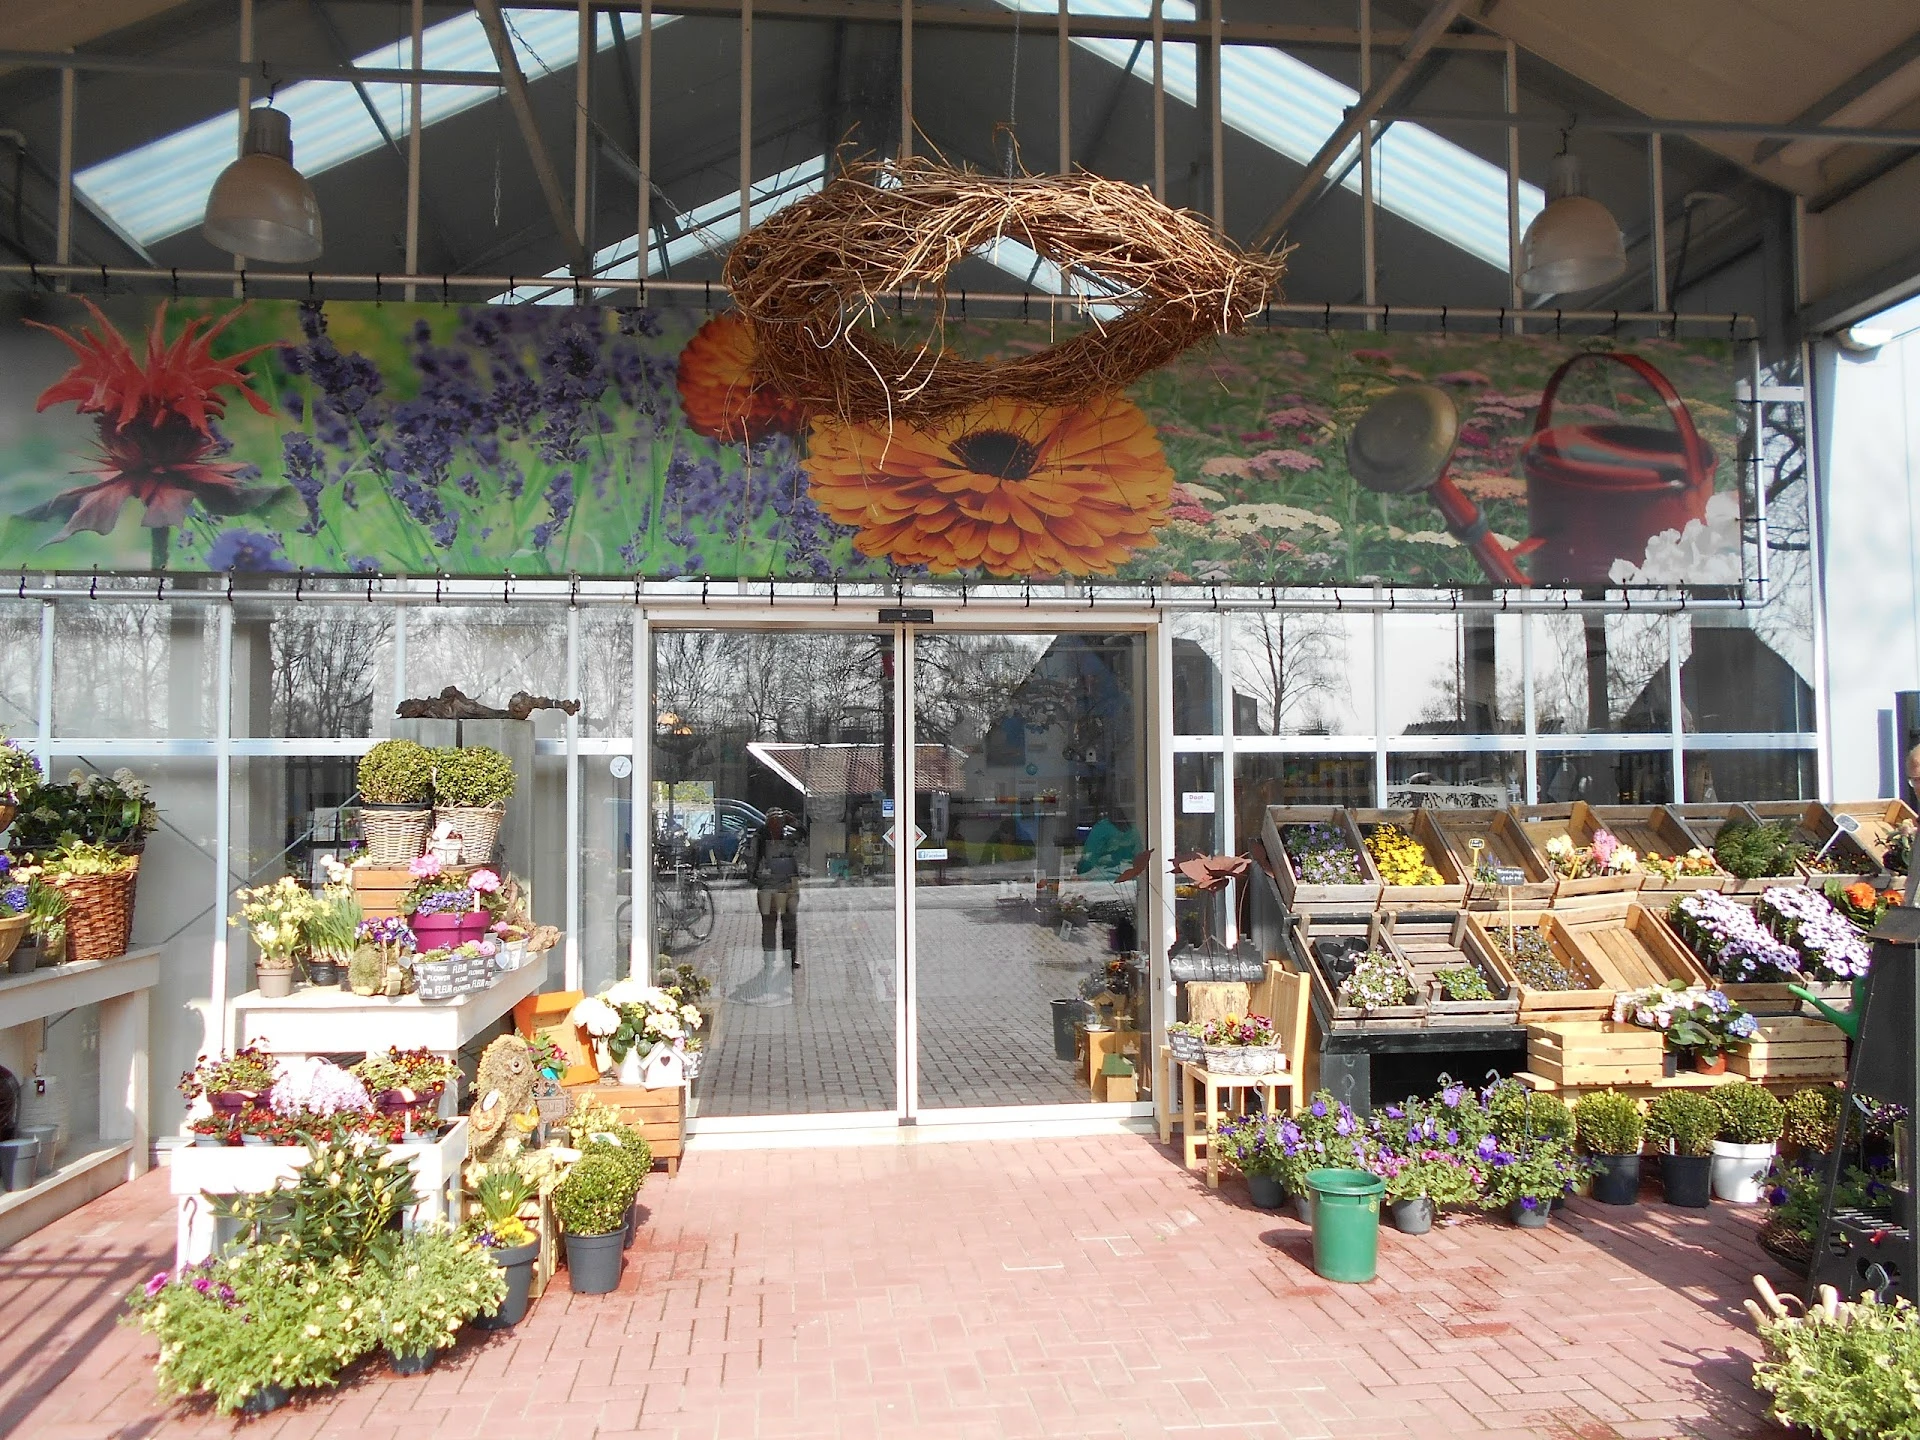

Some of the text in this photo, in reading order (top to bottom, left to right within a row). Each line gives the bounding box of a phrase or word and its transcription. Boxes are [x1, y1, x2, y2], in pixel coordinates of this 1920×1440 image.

[427, 974, 451, 982] FLOWER
[435, 985, 453, 995] FLEUR
[453, 983, 471, 993] FLOWER
